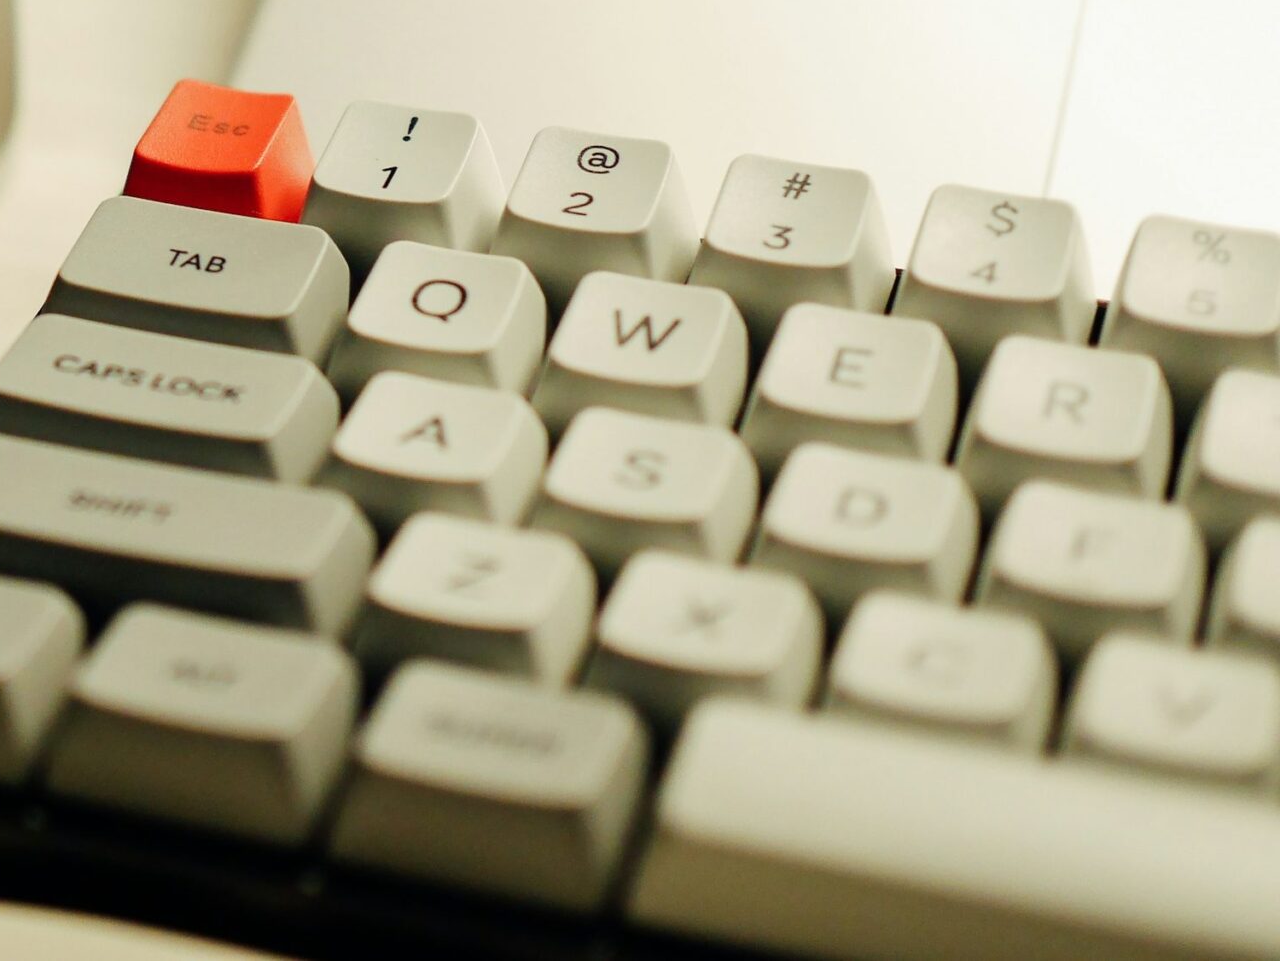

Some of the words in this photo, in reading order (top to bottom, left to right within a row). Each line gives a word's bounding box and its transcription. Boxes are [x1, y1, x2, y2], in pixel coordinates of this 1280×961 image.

[186, 112, 251, 137] Esc
[402, 116, 419, 143] !
[576, 144, 621, 175] @
[381, 165, 399, 190] 1
[782, 172, 812, 200] #
[562, 191, 595, 217] 2
[986, 199, 1020, 238] $
[762, 224, 794, 251] 3
[1191, 228, 1233, 266] %
[169, 248, 227, 274] TAB
[970, 260, 998, 286] 4
[410, 279, 469, 323] Q
[614, 309, 682, 353] W
[53, 354, 145, 388] CAPS
[150, 373, 245, 406] LOCK
[828, 346, 874, 389] E
[1042, 380, 1091, 425] R
[400, 414, 449, 451] A
[617, 449, 666, 490] S
